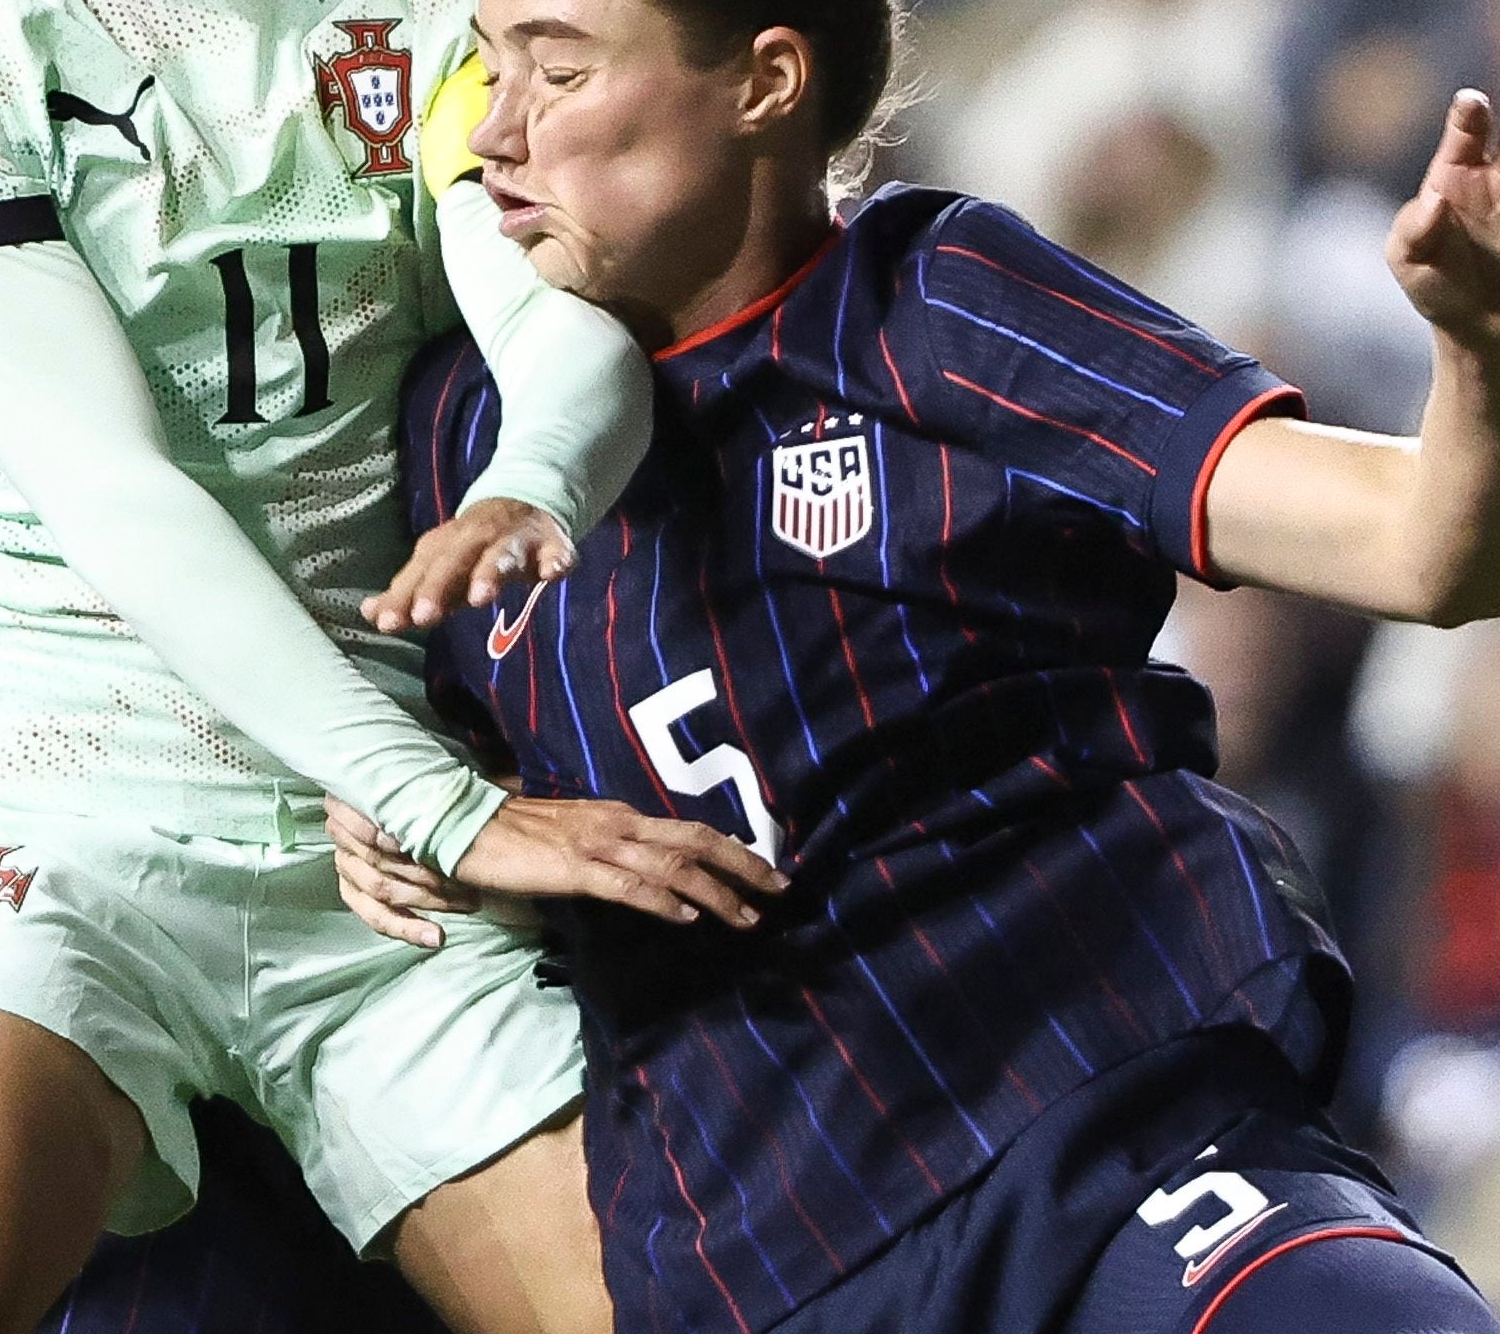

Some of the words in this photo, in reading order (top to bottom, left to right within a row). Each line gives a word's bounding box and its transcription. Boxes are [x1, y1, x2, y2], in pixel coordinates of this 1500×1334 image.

[208, 242, 336, 424] 11
[780, 444, 862, 497] USA
[628, 667, 786, 869] 5
[1136, 1144, 1270, 1259] 5
